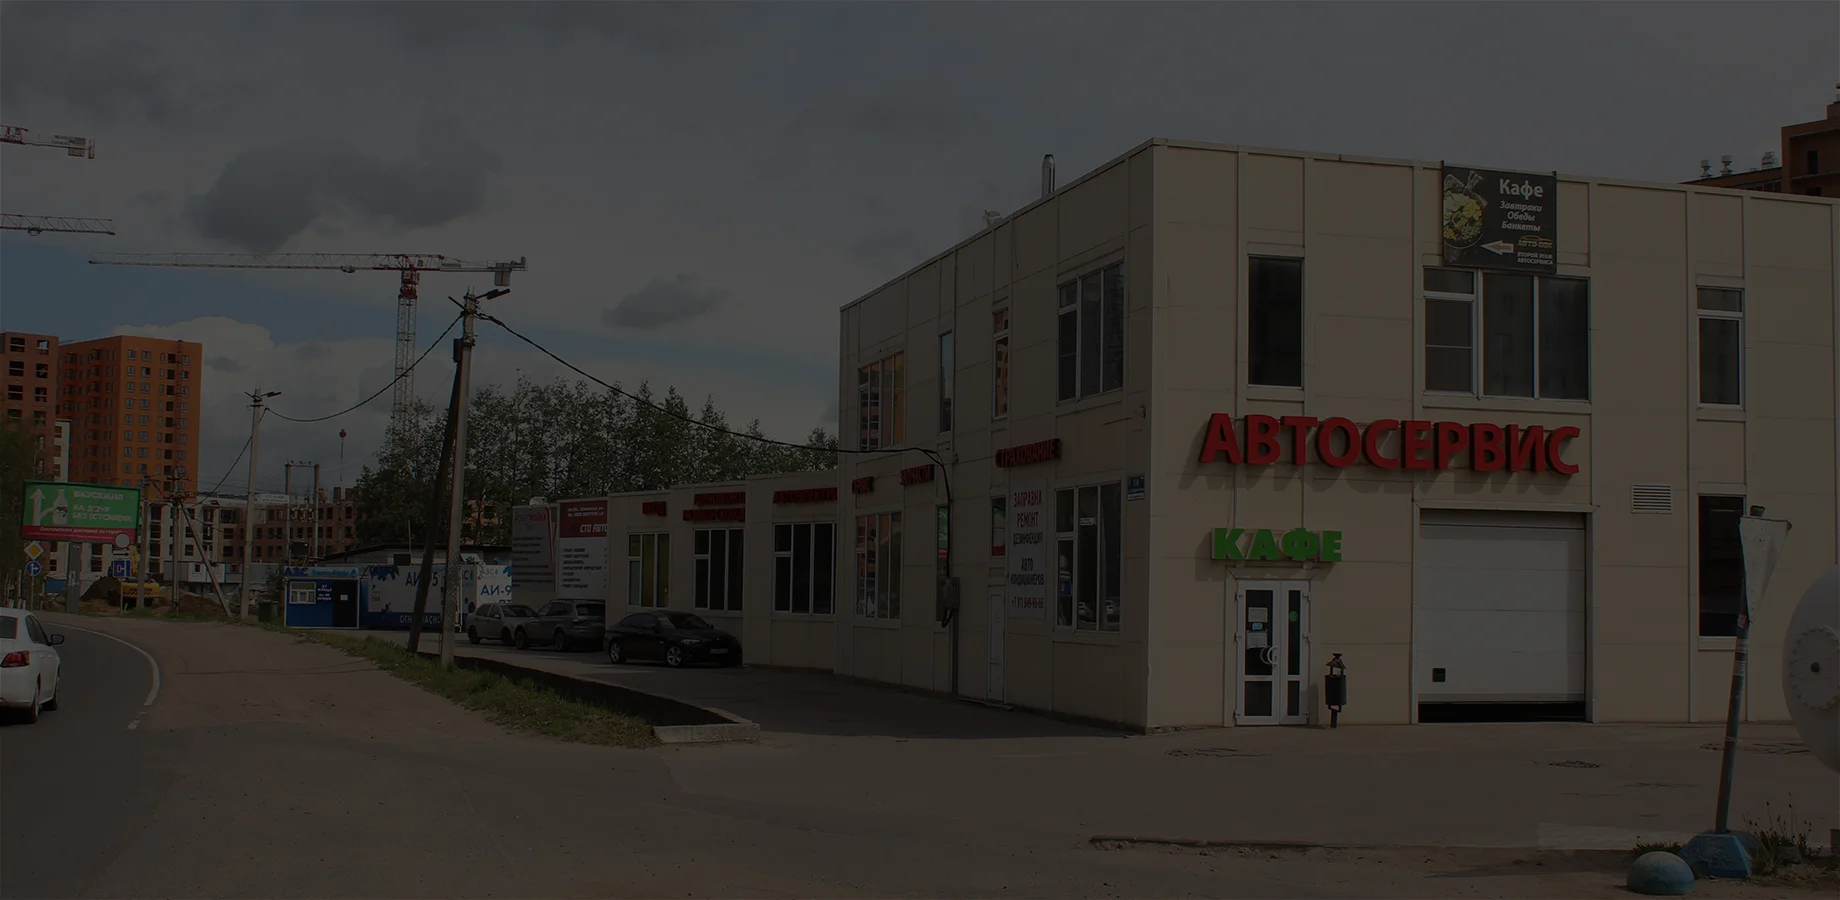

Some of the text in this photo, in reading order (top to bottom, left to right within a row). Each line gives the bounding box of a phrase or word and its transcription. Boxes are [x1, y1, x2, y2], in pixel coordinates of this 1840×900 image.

[1500, 179, 1544, 200] Кафе
[1500, 201, 1543, 212] Завтраки
[1507, 211, 1536, 222] Обеды
[1502, 221, 1541, 231] Банкеты
[1199, 412, 1581, 475] АВТОСЕРВИС
[995, 439, 1061, 468] СТРАХОВАНИЕ
[1016, 512, 1039, 528] РЕМОНТ
[580, 524, 592, 532] СТО
[1211, 527, 1343, 562] КАФЕ
[1021, 558, 1034, 571] АВТО
[283, 567, 308, 577] АЗС
[481, 585, 512, 596] АИ-9
